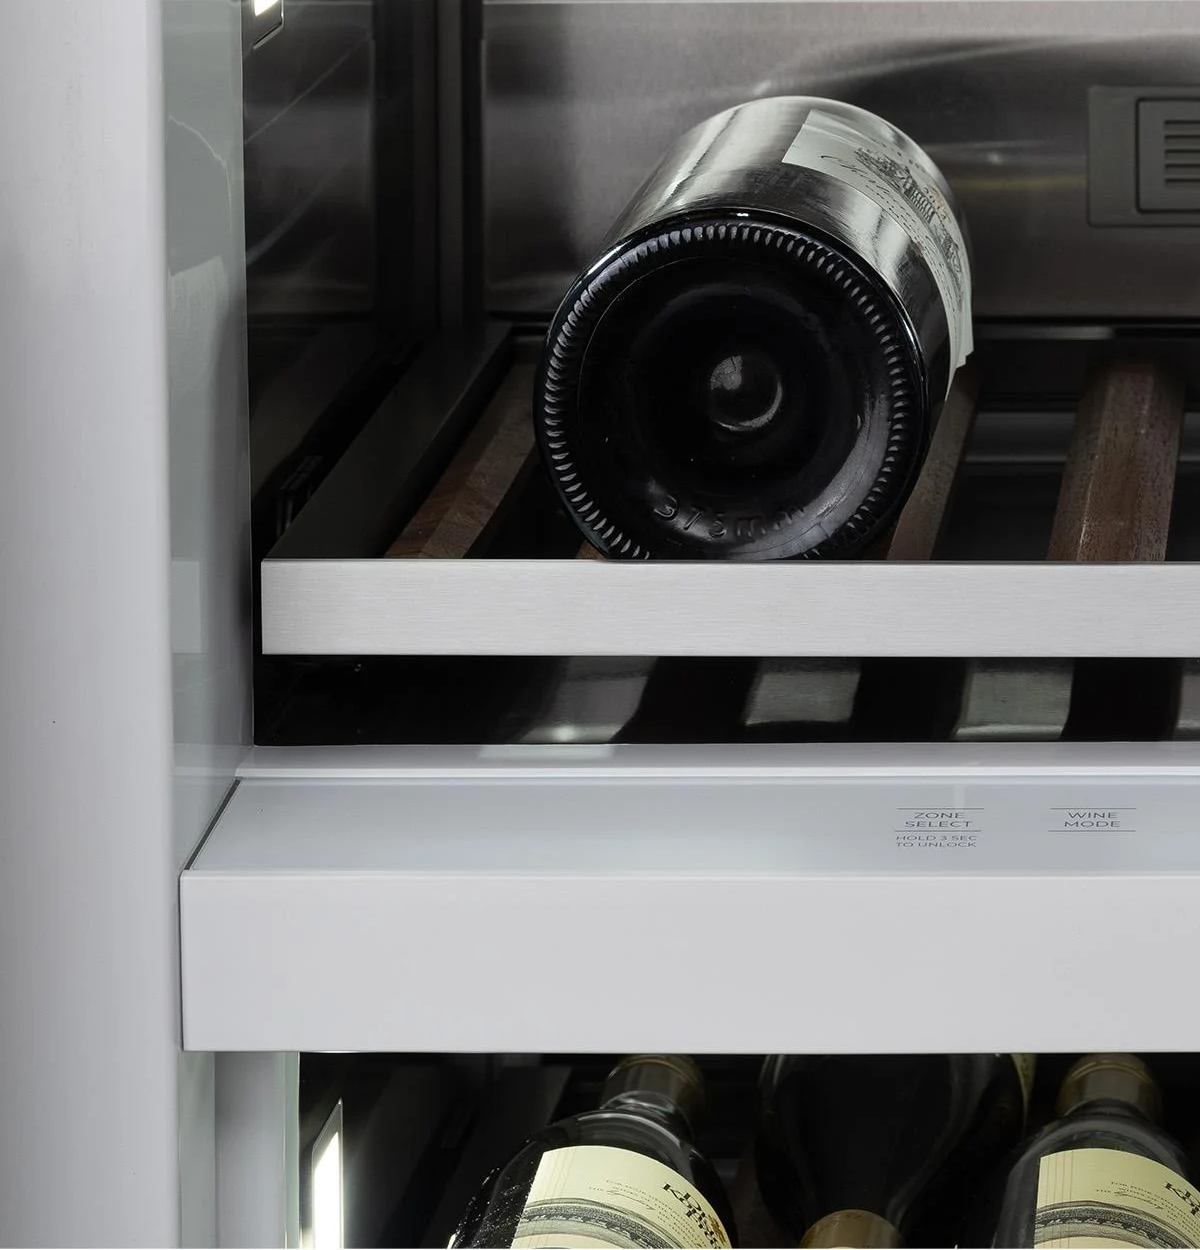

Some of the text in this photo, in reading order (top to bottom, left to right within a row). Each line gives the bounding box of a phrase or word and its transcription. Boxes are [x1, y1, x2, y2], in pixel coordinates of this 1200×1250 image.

[913, 811, 967, 820] ZONE
[1067, 811, 1119, 820] WINE
[904, 820, 974, 828] SELECT
[1063, 820, 1121, 828] MODE
